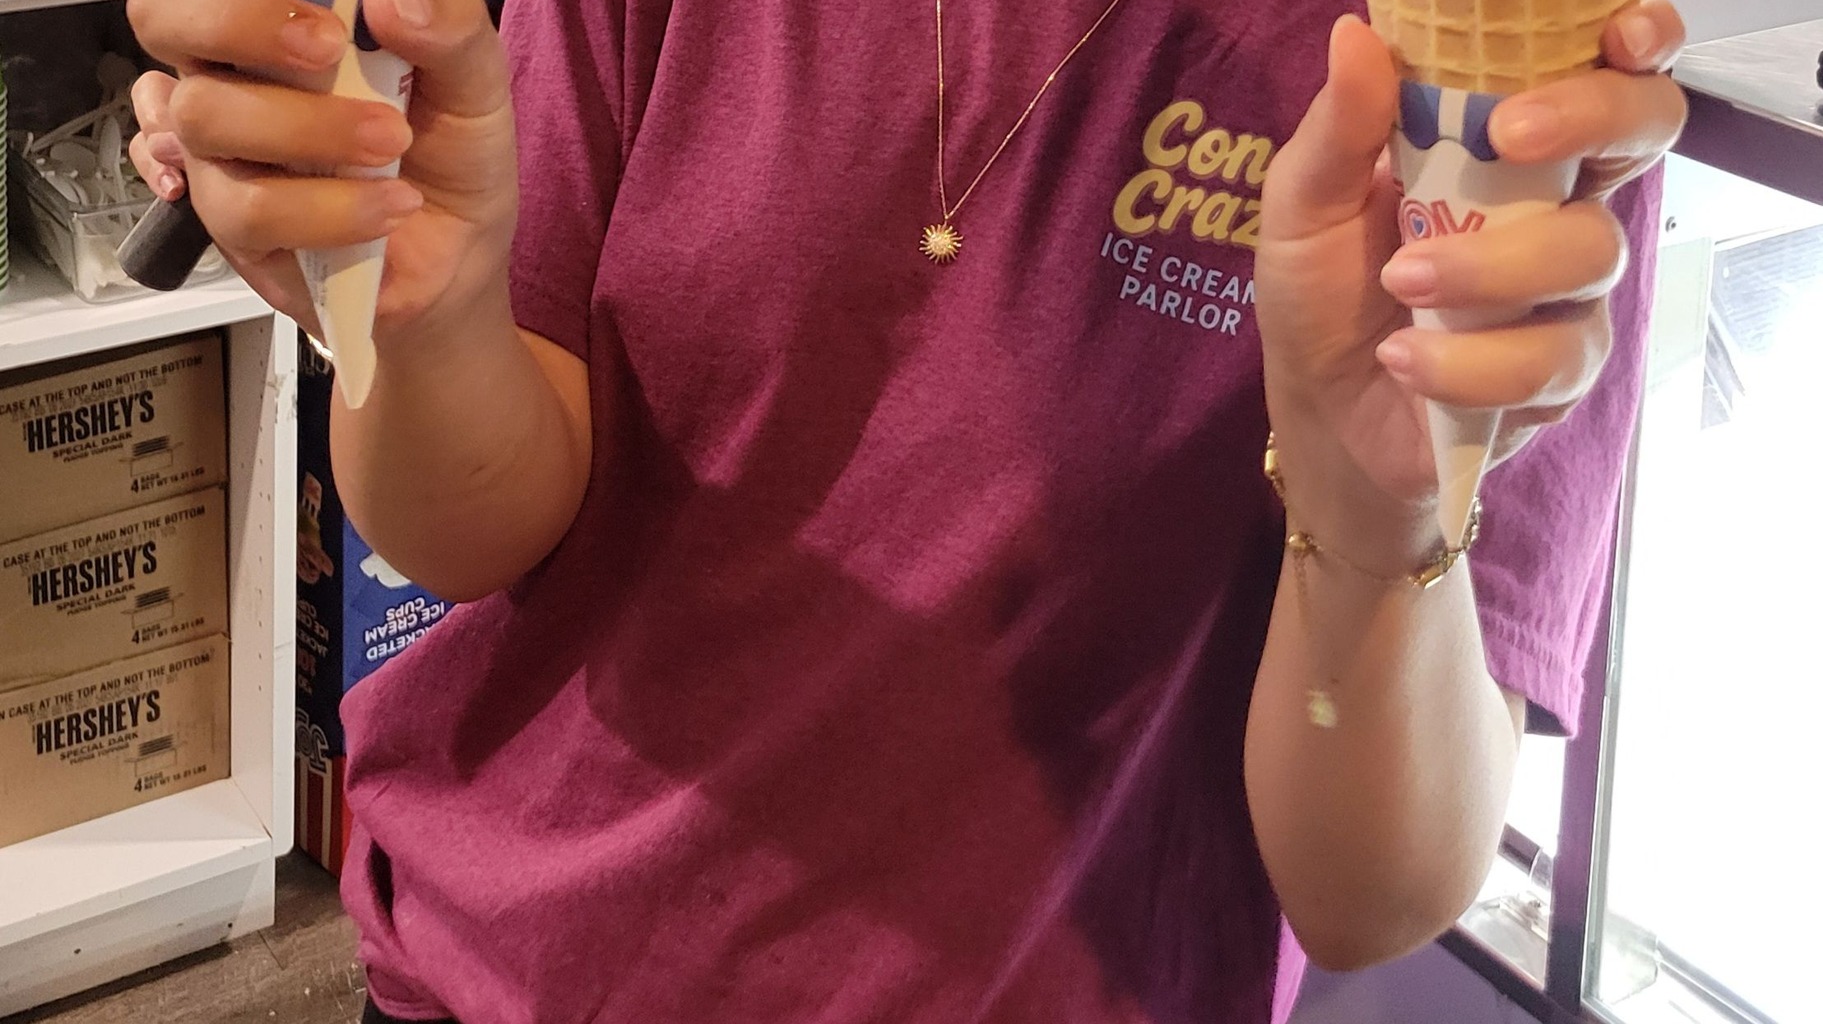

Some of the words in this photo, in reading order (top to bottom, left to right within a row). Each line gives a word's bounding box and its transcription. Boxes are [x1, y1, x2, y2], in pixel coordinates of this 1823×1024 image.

[1143, 101, 1272, 184] Con
[1113, 169, 1261, 246] Craz
[1101, 232, 1153, 273] ICE
[1120, 275, 1241, 336] PARLOR
[0, 402, 25, 415] CASE
[30, 397, 42, 408] AT
[45, 391, 65, 404] THE
[67, 384, 88, 399] TOP
[91, 378, 112, 393] AND
[115, 372, 138, 385] NOT
[139, 366, 158, 379] THE
[161, 356, 204, 374] BOTTOM
[28, 390, 155, 453] HERSHEY'S
[53, 442, 98, 458] SPECIAL
[102, 431, 133, 446] DARK
[131, 479, 139, 493] 4
[3, 554, 30, 568] CASE
[33, 549, 46, 560] AT
[49, 543, 69, 556] THE
[71, 536, 92, 550] TOP
[95, 529, 116, 544] AND
[119, 524, 141, 537] NOT
[142, 518, 161, 531] THE
[164, 505, 205, 525] BOTTOM
[32, 541, 157, 606] HERSHEY'S
[56, 595, 101, 612] SPECIAL
[105, 584, 136, 598] DARK
[386, 597, 425, 622] CUPS
[421, 601, 445, 623] ICE
[131, 630, 140, 644] 4
[364, 613, 418, 645] CREAM
[366, 624, 434, 662] CKETED
[9, 703, 36, 718] CASE
[38, 697, 51, 710] AT
[54, 692, 74, 705] THE
[77, 685, 97, 699] TOP
[100, 678, 121, 693] AND
[124, 673, 145, 685] NOT
[147, 666, 166, 680] THE
[169, 653, 210, 673] BOTTOM
[36, 690, 161, 756] HERSHEY'S
[59, 743, 104, 760] SPECIAL
[108, 732, 139, 747] DARK
[134, 778, 142, 792] 4
